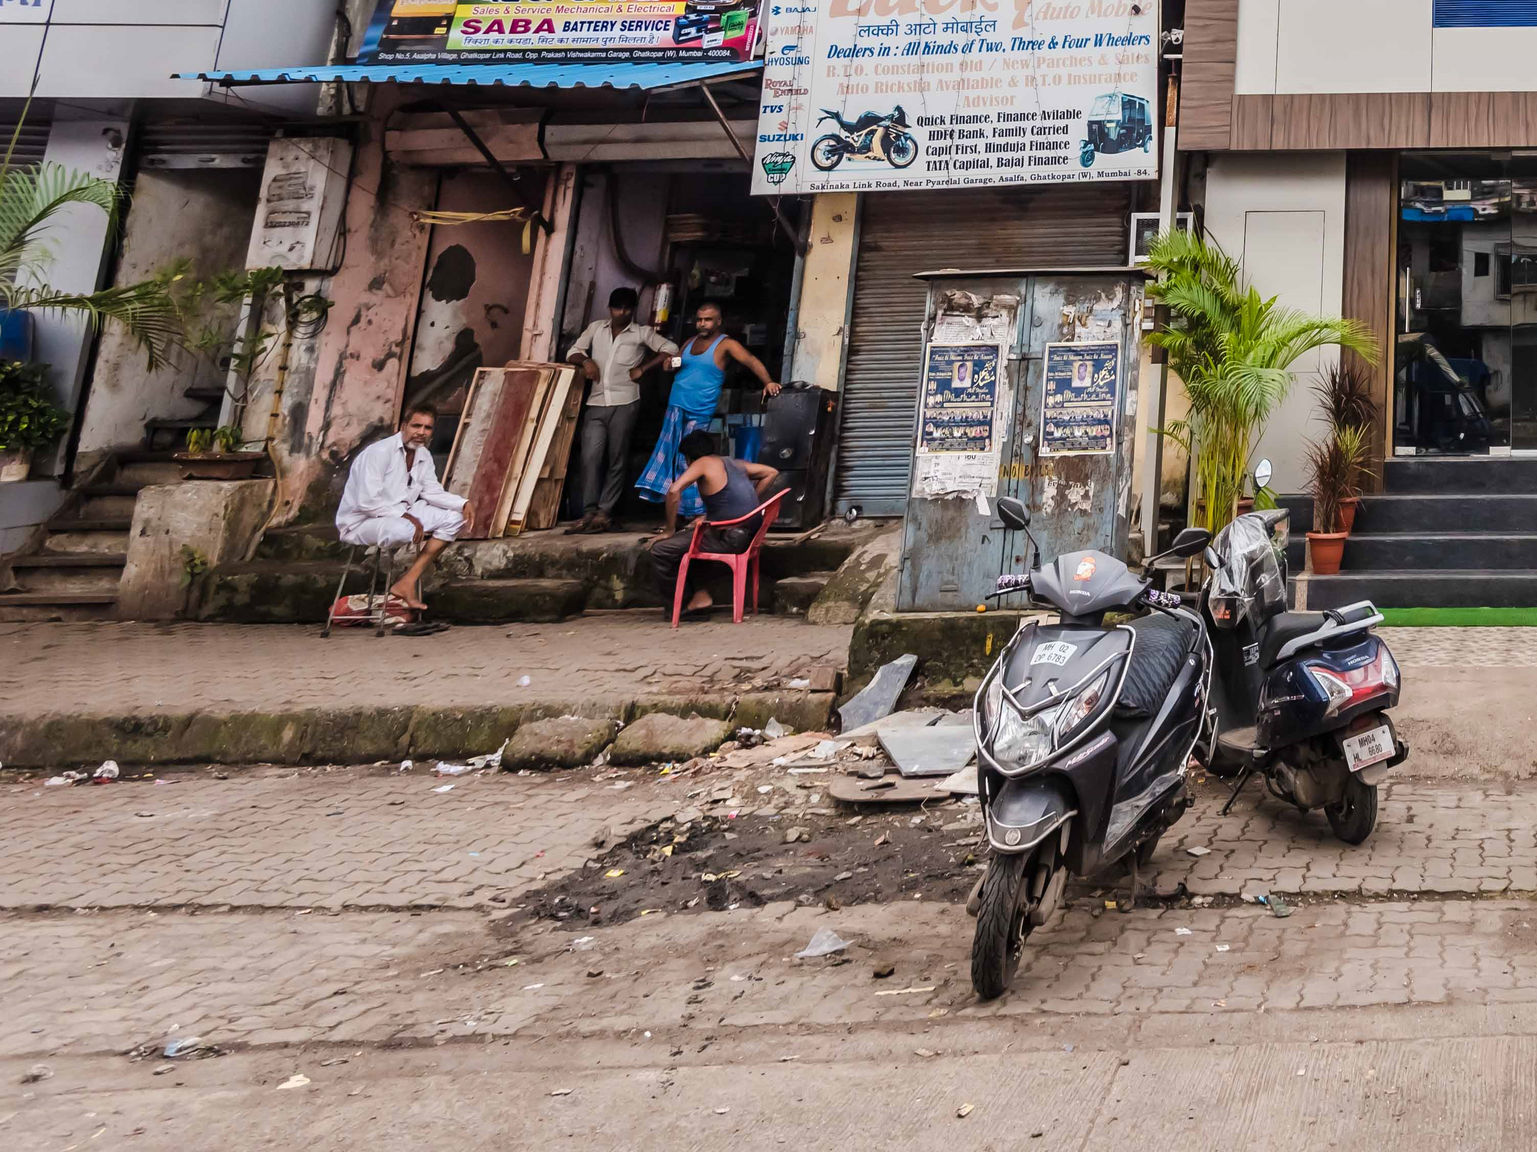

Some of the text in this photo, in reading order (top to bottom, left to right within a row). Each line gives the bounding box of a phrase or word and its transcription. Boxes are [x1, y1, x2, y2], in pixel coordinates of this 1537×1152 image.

[472, 3, 675, 16] Sales & Service Mechanical & Electrical
[1034, 0, 1081, 21] Auto
[460, 18, 671, 35] SABA BATTERY SERVICE
[780, 25, 814, 36] YAMAHA
[858, 15, 998, 38] लक्की आटो मोबाईल
[827, 43, 875, 59] Dealers
[877, 42, 891, 56] in
[901, 41, 921, 56] All
[921, 40, 958, 56] Kinds
[962, 38, 976, 54] of
[1010, 36, 1045, 52] Three
[1048, 35, 1059, 50] &
[1061, 34, 1091, 49] Four
[1093, 32, 1151, 48] Wheelers
[378, 52, 395, 61] Shop
[460, 51, 491, 61] Ghatkopar
[492, 51, 505, 59] Link
[541, 50, 565, 59] Prakash
[567, 50, 606, 58] Vishwakarma
[633, 49, 664, 59] Ghatkopar
[678, 49, 703, 57] Mumbai
[767, 56, 810, 66] HYOSUNG
[1002, 57, 1031, 72] New
[1036, 55, 1093, 70] Parches
[1096, 53, 1109, 66] &
[1114, 52, 1151, 66] Sales
[836, 81, 870, 96] Auto
[1007, 75, 1020, 88] &
[1067, 71, 1138, 86] Insurance
[762, 104, 784, 114] TVS
[962, 95, 1016, 109] Advisor
[917, 108, 1082, 128] Quick Finance, Finance Avilable
[759, 133, 804, 143] SUZUKI
[957, 128, 988, 140] Bank,
[992, 125, 1027, 139] Family
[1030, 124, 1069, 137] Carried
[955, 140, 1070, 156] First, Hinduja Finance
[926, 154, 1069, 172] TATA Capital, Bajaj Finance
[810, 169, 1131, 191] Sakinaka Link Road, Near Pyarelal Garage, Asalfa, Ghatkopar (W), Mumbai
[1043, 643, 1070, 653] MH 02
[1047, 653, 1066, 665] 6783
[1358, 734, 1376, 747] MH04
